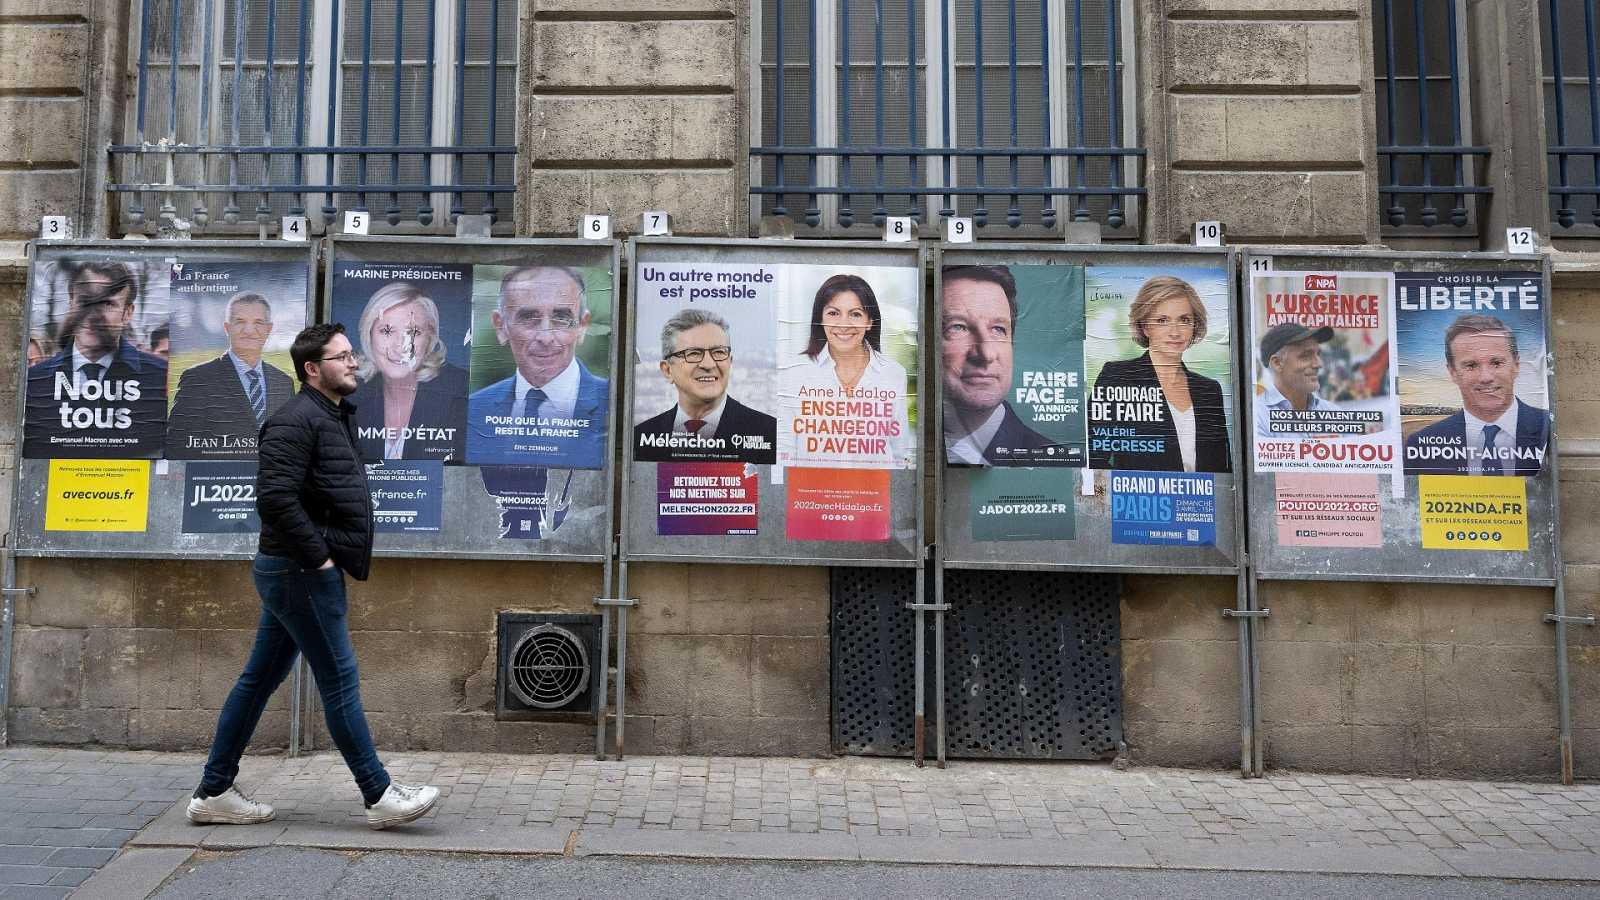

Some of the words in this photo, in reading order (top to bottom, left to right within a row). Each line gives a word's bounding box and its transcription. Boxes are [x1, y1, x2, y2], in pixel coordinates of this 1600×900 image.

[50, 221, 58, 232] 3
[290, 221, 298, 233] 4
[352, 216, 361, 228] 5
[592, 220, 600, 231] 6
[651, 216, 660, 228] 7
[894, 221, 903, 233] 8
[955, 222, 964, 234] 9
[1199, 225, 1217, 238] 10
[1511, 232, 1529, 245] 12
[1253, 260, 1268, 271] 11
[177, 272, 192, 280] La
[194, 272, 230, 280] France
[344, 269, 390, 279] MARINE
[392, 268, 462, 280] PRÉSIDENTE
[643, 268, 665, 282] Un
[669, 269, 713, 282] autre
[717, 269, 773, 284] monde
[177, 283, 239, 293] authentique
[1316, 279, 1335, 288] NPA
[660, 286, 684, 298] est
[690, 284, 757, 302] possible
[1400, 280, 1539, 310] LIBERTÉ
[1266, 294, 1379, 314] L'URGENCE
[1268, 314, 1378, 328] ANTICAPITALISTE
[1023, 371, 1078, 387] FAIRE
[54, 371, 141, 401] Nous
[798, 385, 834, 397] Anne
[839, 387, 896, 401] Hidalgo
[1016, 388, 1065, 403] FACE
[1091, 386, 1104, 401] LE
[1106, 386, 1163, 402] COURAGE
[801, 400, 893, 417] ENSEMBLE
[1032, 405, 1078, 413] YANNICK
[1091, 402, 1112, 421] DE
[1116, 403, 1164, 421] FAIRE
[59, 402, 132, 429] tous
[485, 416, 513, 425] POUR
[515, 417, 535, 425] QUE
[537, 418, 549, 426] LA
[551, 418, 590, 427] FRANCE
[1032, 414, 1066, 422] JADOT
[1271, 411, 1293, 419] NOS
[1295, 411, 1316, 419] VIES
[1318, 412, 1354, 420] VALENT
[1357, 412, 1380, 420] PLUS
[358, 427, 397, 439] MME
[401, 424, 457, 440] D'ÉTAT
[495, 427, 524, 436] RESTE
[527, 428, 538, 436] LA
[540, 428, 579, 438] FRANCE
[793, 418, 900, 437] CHANGEONS
[1092, 426, 1136, 437] VALÉRIE
[1271, 423, 1291, 432] QUE
[1294, 424, 1322, 432] LEURS
[1325, 424, 1363, 432] PROFITS
[639, 433, 726, 449] Mélenchon
[807, 437, 887, 454] D'AVENIR
[1092, 437, 1165, 452] PÉCRESSE
[1418, 436, 1462, 445] NICOLAS
[1258, 443, 1295, 452] VOTEZ
[1300, 443, 1393, 461] POUTOU
[1407, 446, 1545, 460] DUPONT-AIGNAN
[1258, 452, 1296, 460] PHILIPPE
[674, 476, 718, 486] RETROUVEZ
[720, 477, 741, 486] TOUS
[1113, 477, 1155, 494] GRAND
[1159, 478, 1213, 495] MEETING
[63, 489, 134, 500] avecvous.fr
[670, 488, 686, 499] NOS
[688, 488, 727, 499] MEETINGS
[729, 489, 746, 499] SUR
[662, 505, 753, 513] MELENCHON2022.FR
[793, 501, 882, 512] 2022avecHidalgo.fr
[979, 504, 1066, 514] JADOT2022.FR
[1113, 495, 1172, 521] PARIS
[1279, 502, 1377, 511] POUTOU2022.ORG
[1426, 502, 1522, 514] 2022NDA.FR
